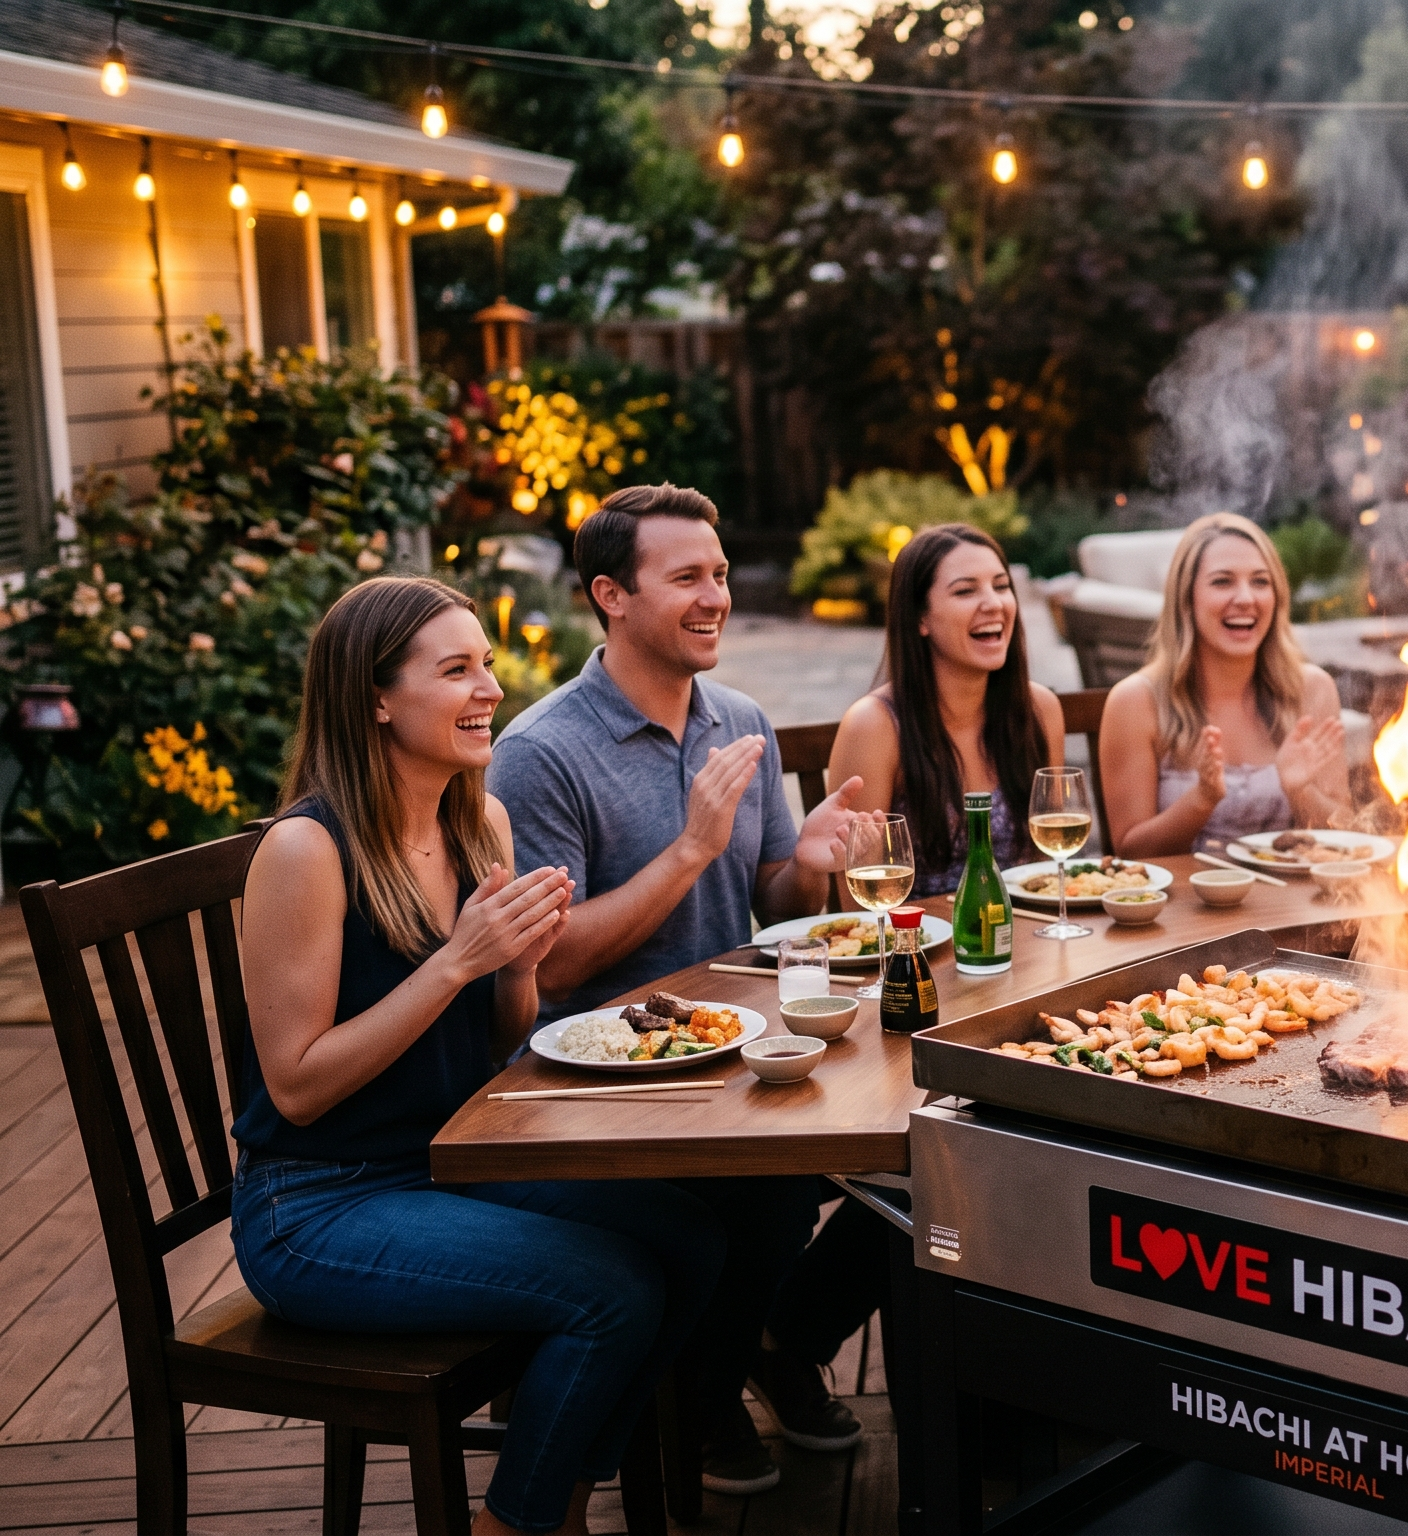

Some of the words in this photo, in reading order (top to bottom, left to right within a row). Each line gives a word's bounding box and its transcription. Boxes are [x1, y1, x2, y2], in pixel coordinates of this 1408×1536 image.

[1171, 1382, 1312, 1449] HIBACHI
[1323, 1427, 1368, 1464] AT
[1274, 1450, 1386, 1500] IMPERIAL
